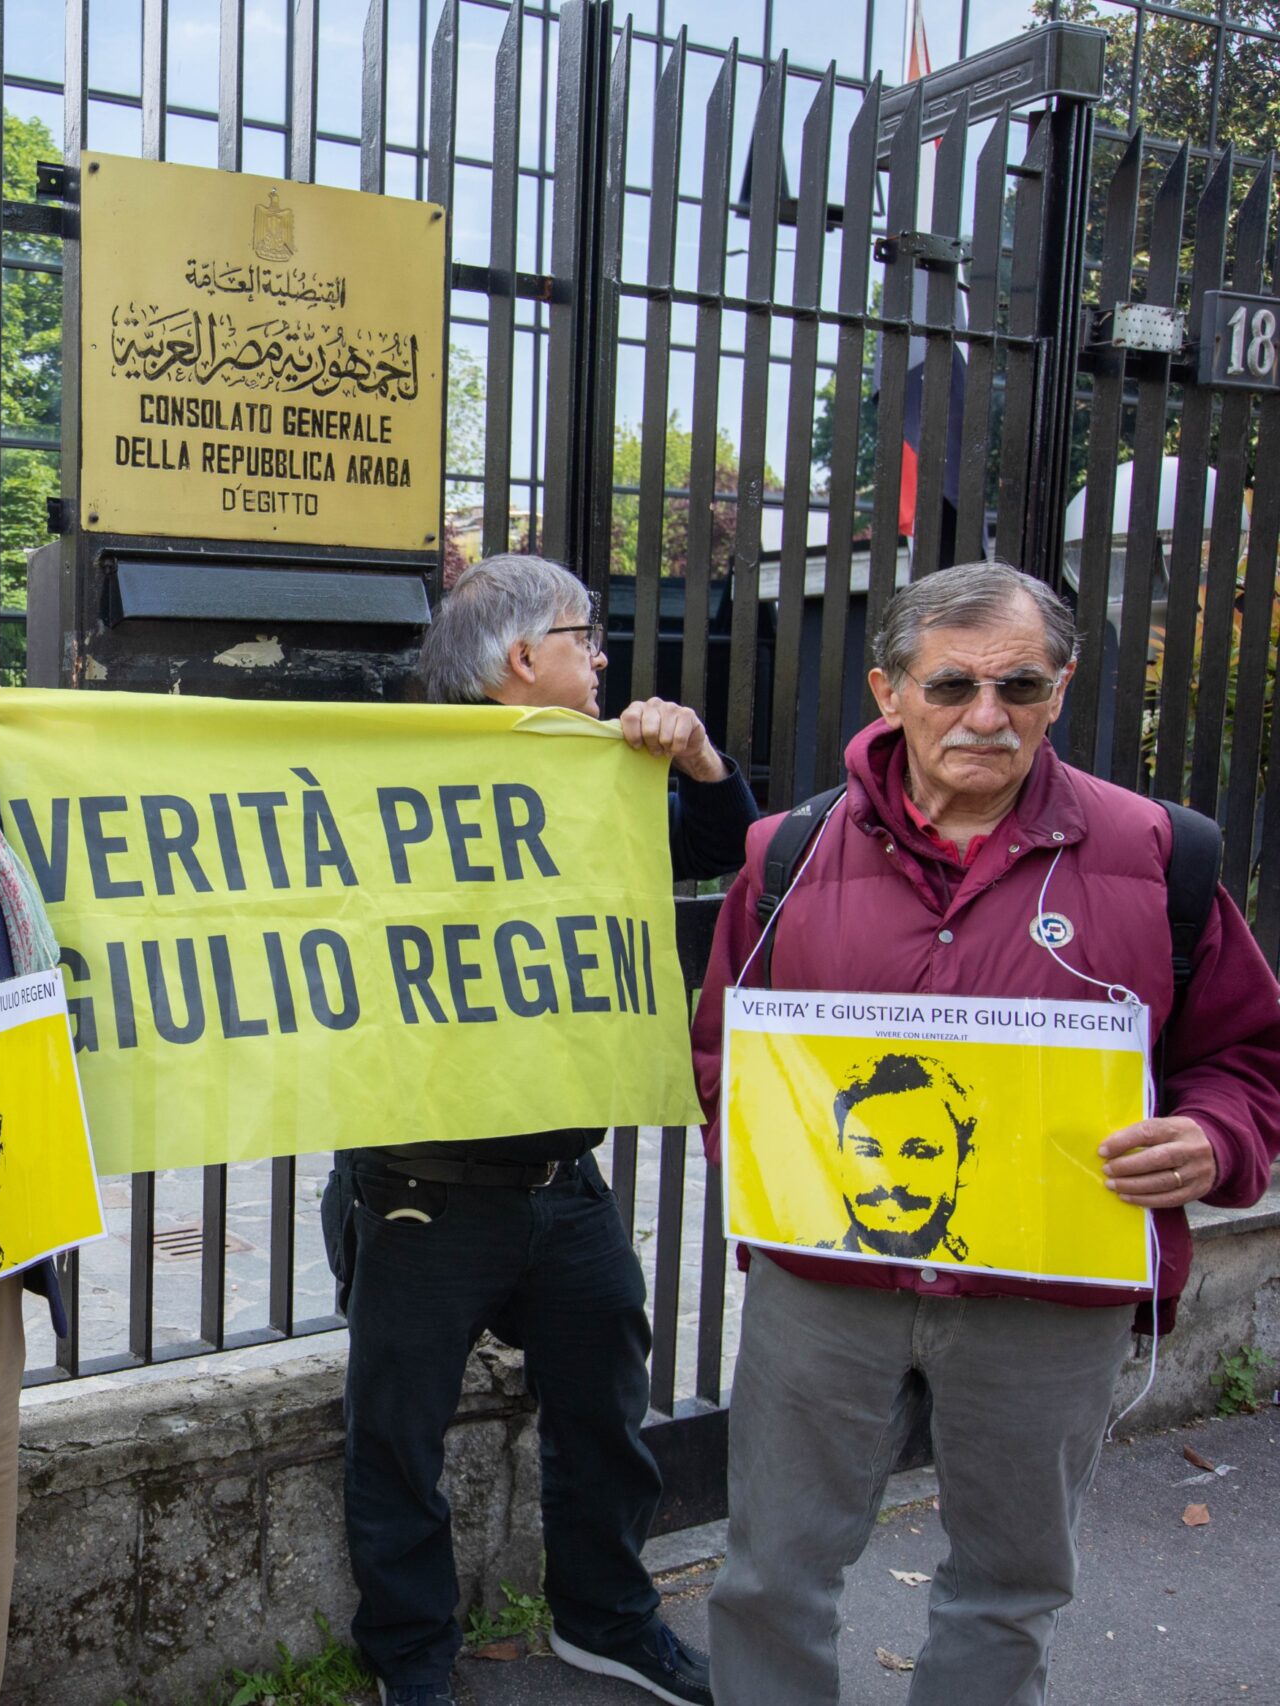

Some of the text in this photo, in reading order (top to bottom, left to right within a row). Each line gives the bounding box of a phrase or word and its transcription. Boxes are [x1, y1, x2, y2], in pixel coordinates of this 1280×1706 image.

[1227, 306, 1276, 378] 18
[140, 393, 392, 444] CONSOLATO GENERALE
[115, 435, 412, 488] DELLA REPUBBLICA ARABA
[222, 483, 319, 517] D'EGITTO
[9, 767, 561, 903] VERITÀ PER
[21, 981, 56, 1004] REGENI
[385, 914, 657, 1025] REGENI
[742, 1000, 1134, 1033] VERITA' E GIUSTIZIA PER GIULIO REGENI
[875, 1030, 968, 1041] VIVERE CON LENTEZZA.IT
